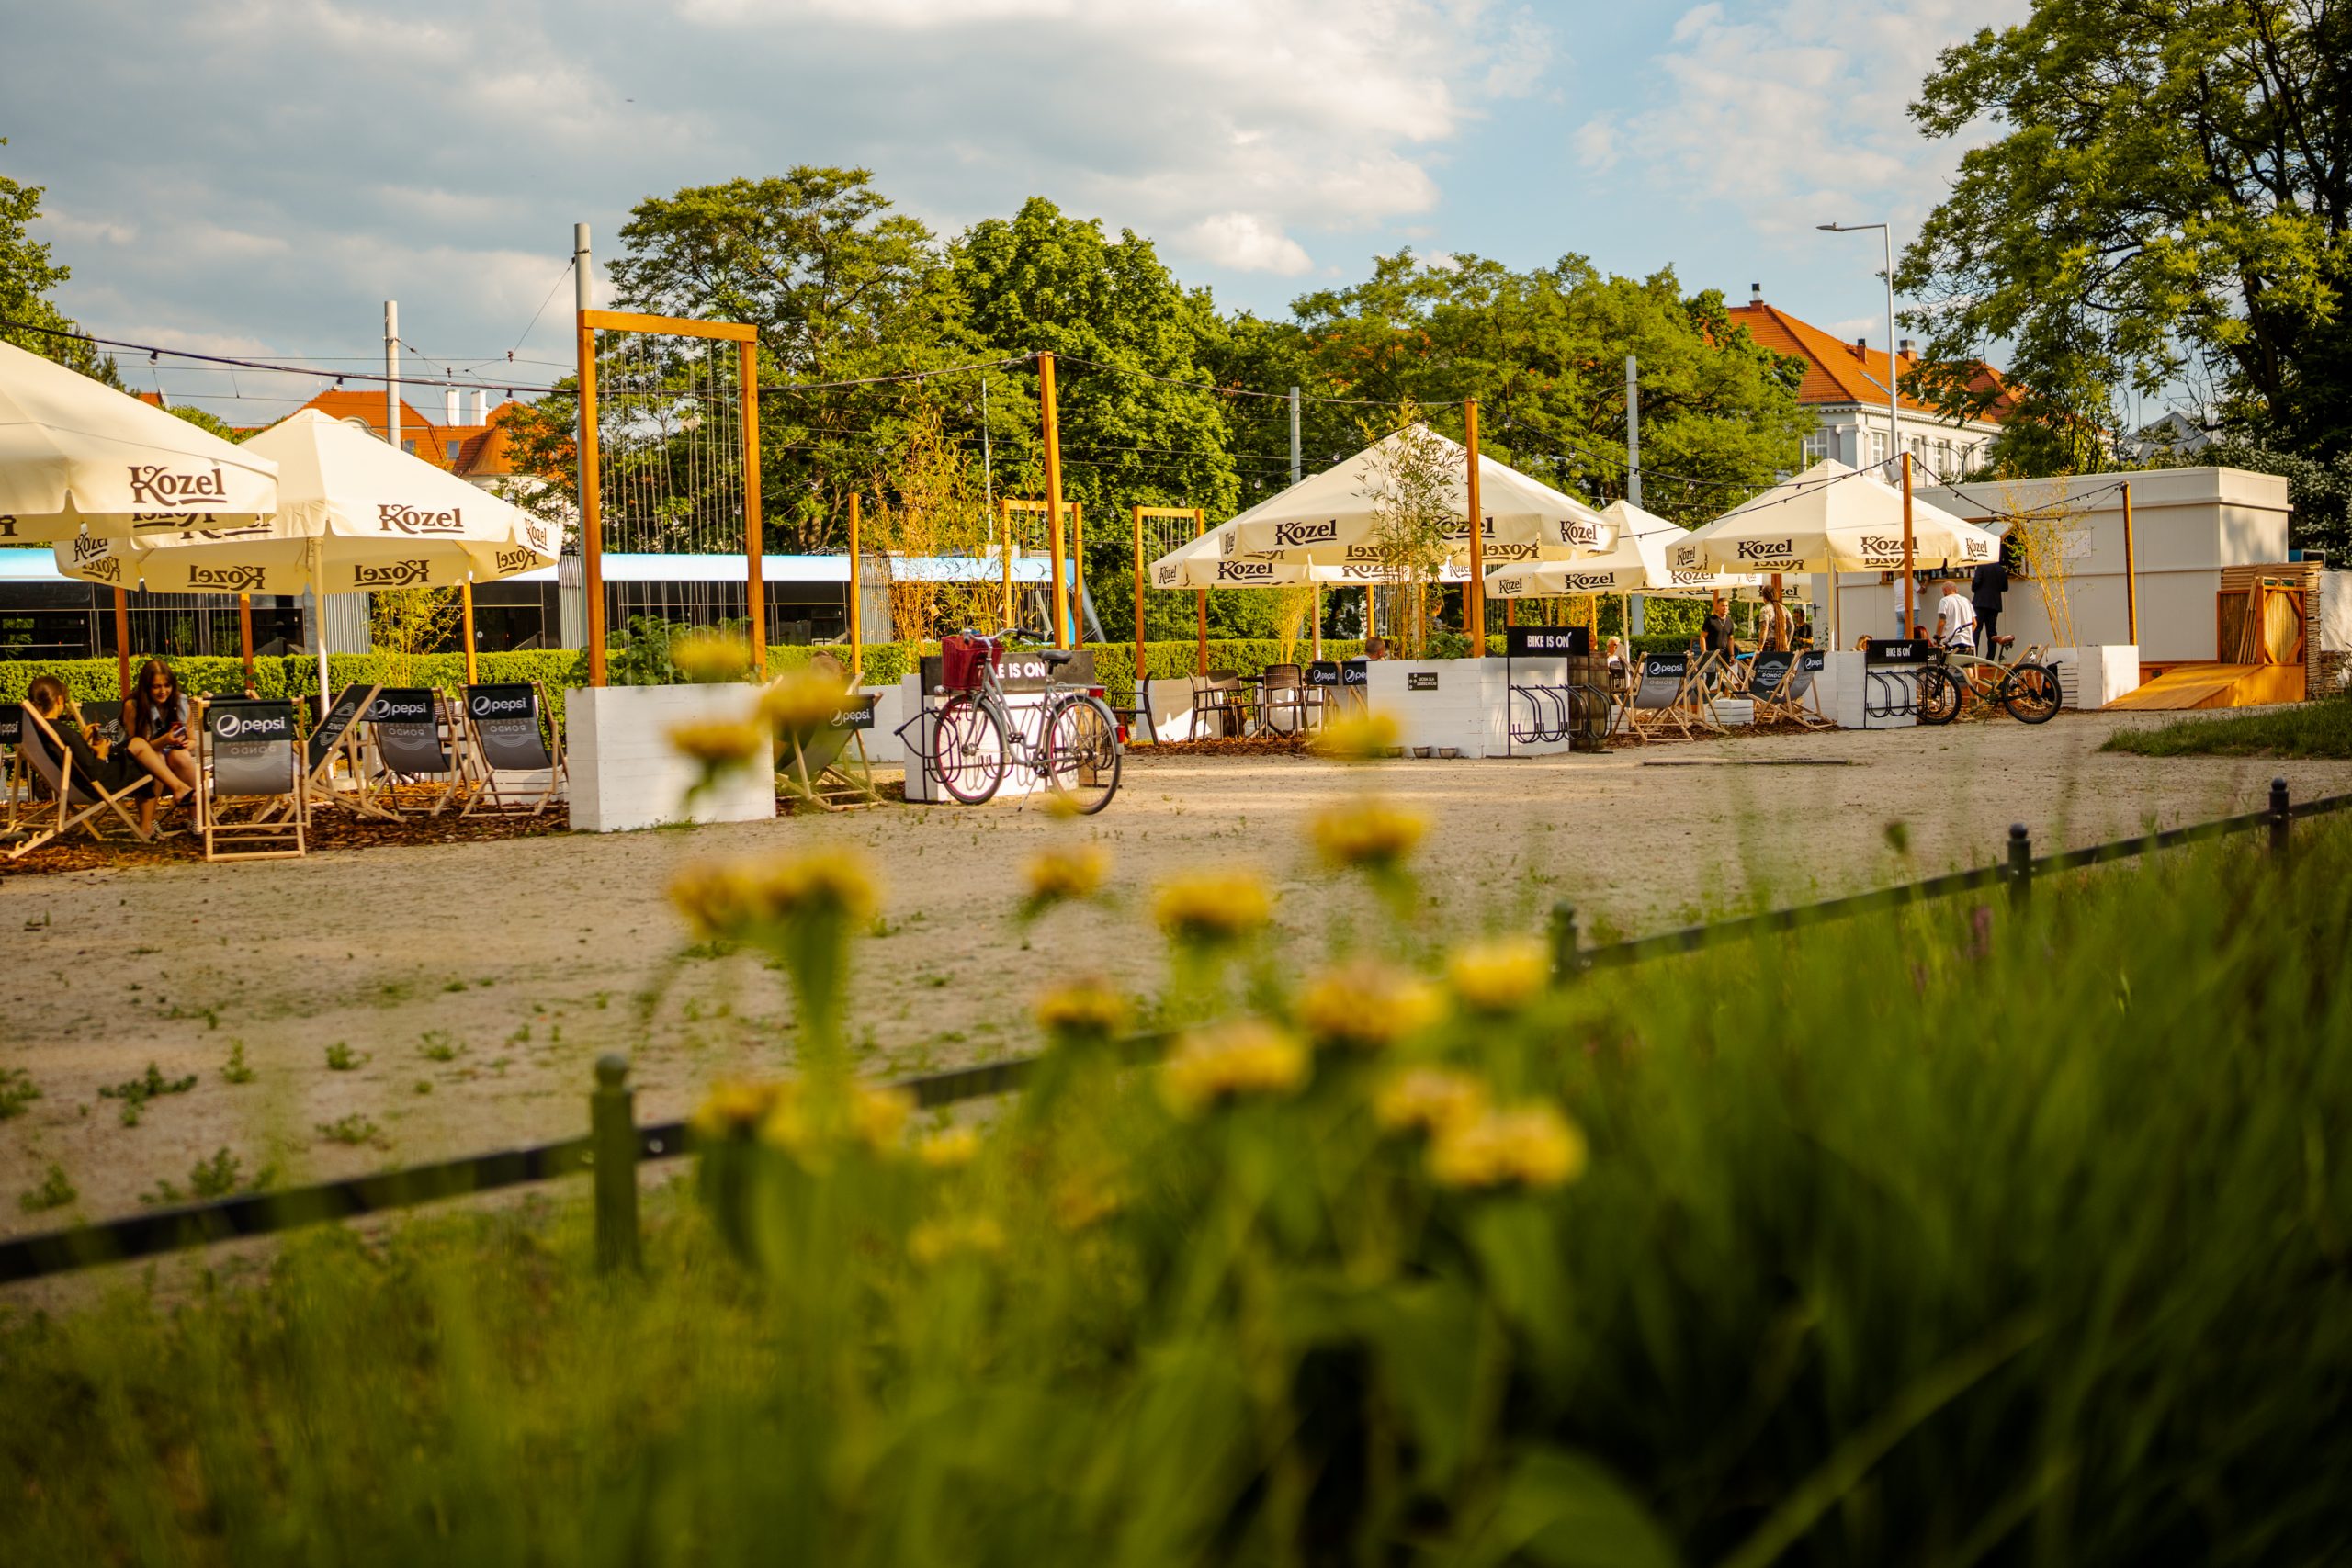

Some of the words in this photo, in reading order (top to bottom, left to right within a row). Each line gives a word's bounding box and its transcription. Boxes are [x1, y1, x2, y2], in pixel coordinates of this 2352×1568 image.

[127, 466, 228, 506] Kozel
[378, 504, 465, 535] Kozel
[1422, 515, 1496, 540] ozl
[525, 518, 548, 551] Kozel
[1275, 519, 1338, 546] Kozel
[1560, 520, 1597, 545] Kozel
[1677, 546, 1696, 565] Kozel
[1737, 539, 1793, 559] Kozel
[1965, 537, 1988, 557] Kozel
[1159, 565, 1177, 584] Kozel
[1217, 561, 1273, 580] Kozel
[1499, 578, 1522, 594] Kozel
[1565, 572, 1615, 590] Kozel
[1527, 635, 1544, 648] BIKE
[1546, 635, 1555, 648] IS
[1886, 647, 1896, 657] BIKE
[1008, 662, 1022, 678] IS
[1661, 663, 1683, 674] pepsi
[391, 702, 427, 716] pepsi
[492, 697, 526, 713] pepsi
[242, 716, 287, 734] pepsi
[842, 708, 871, 723] pepsi
